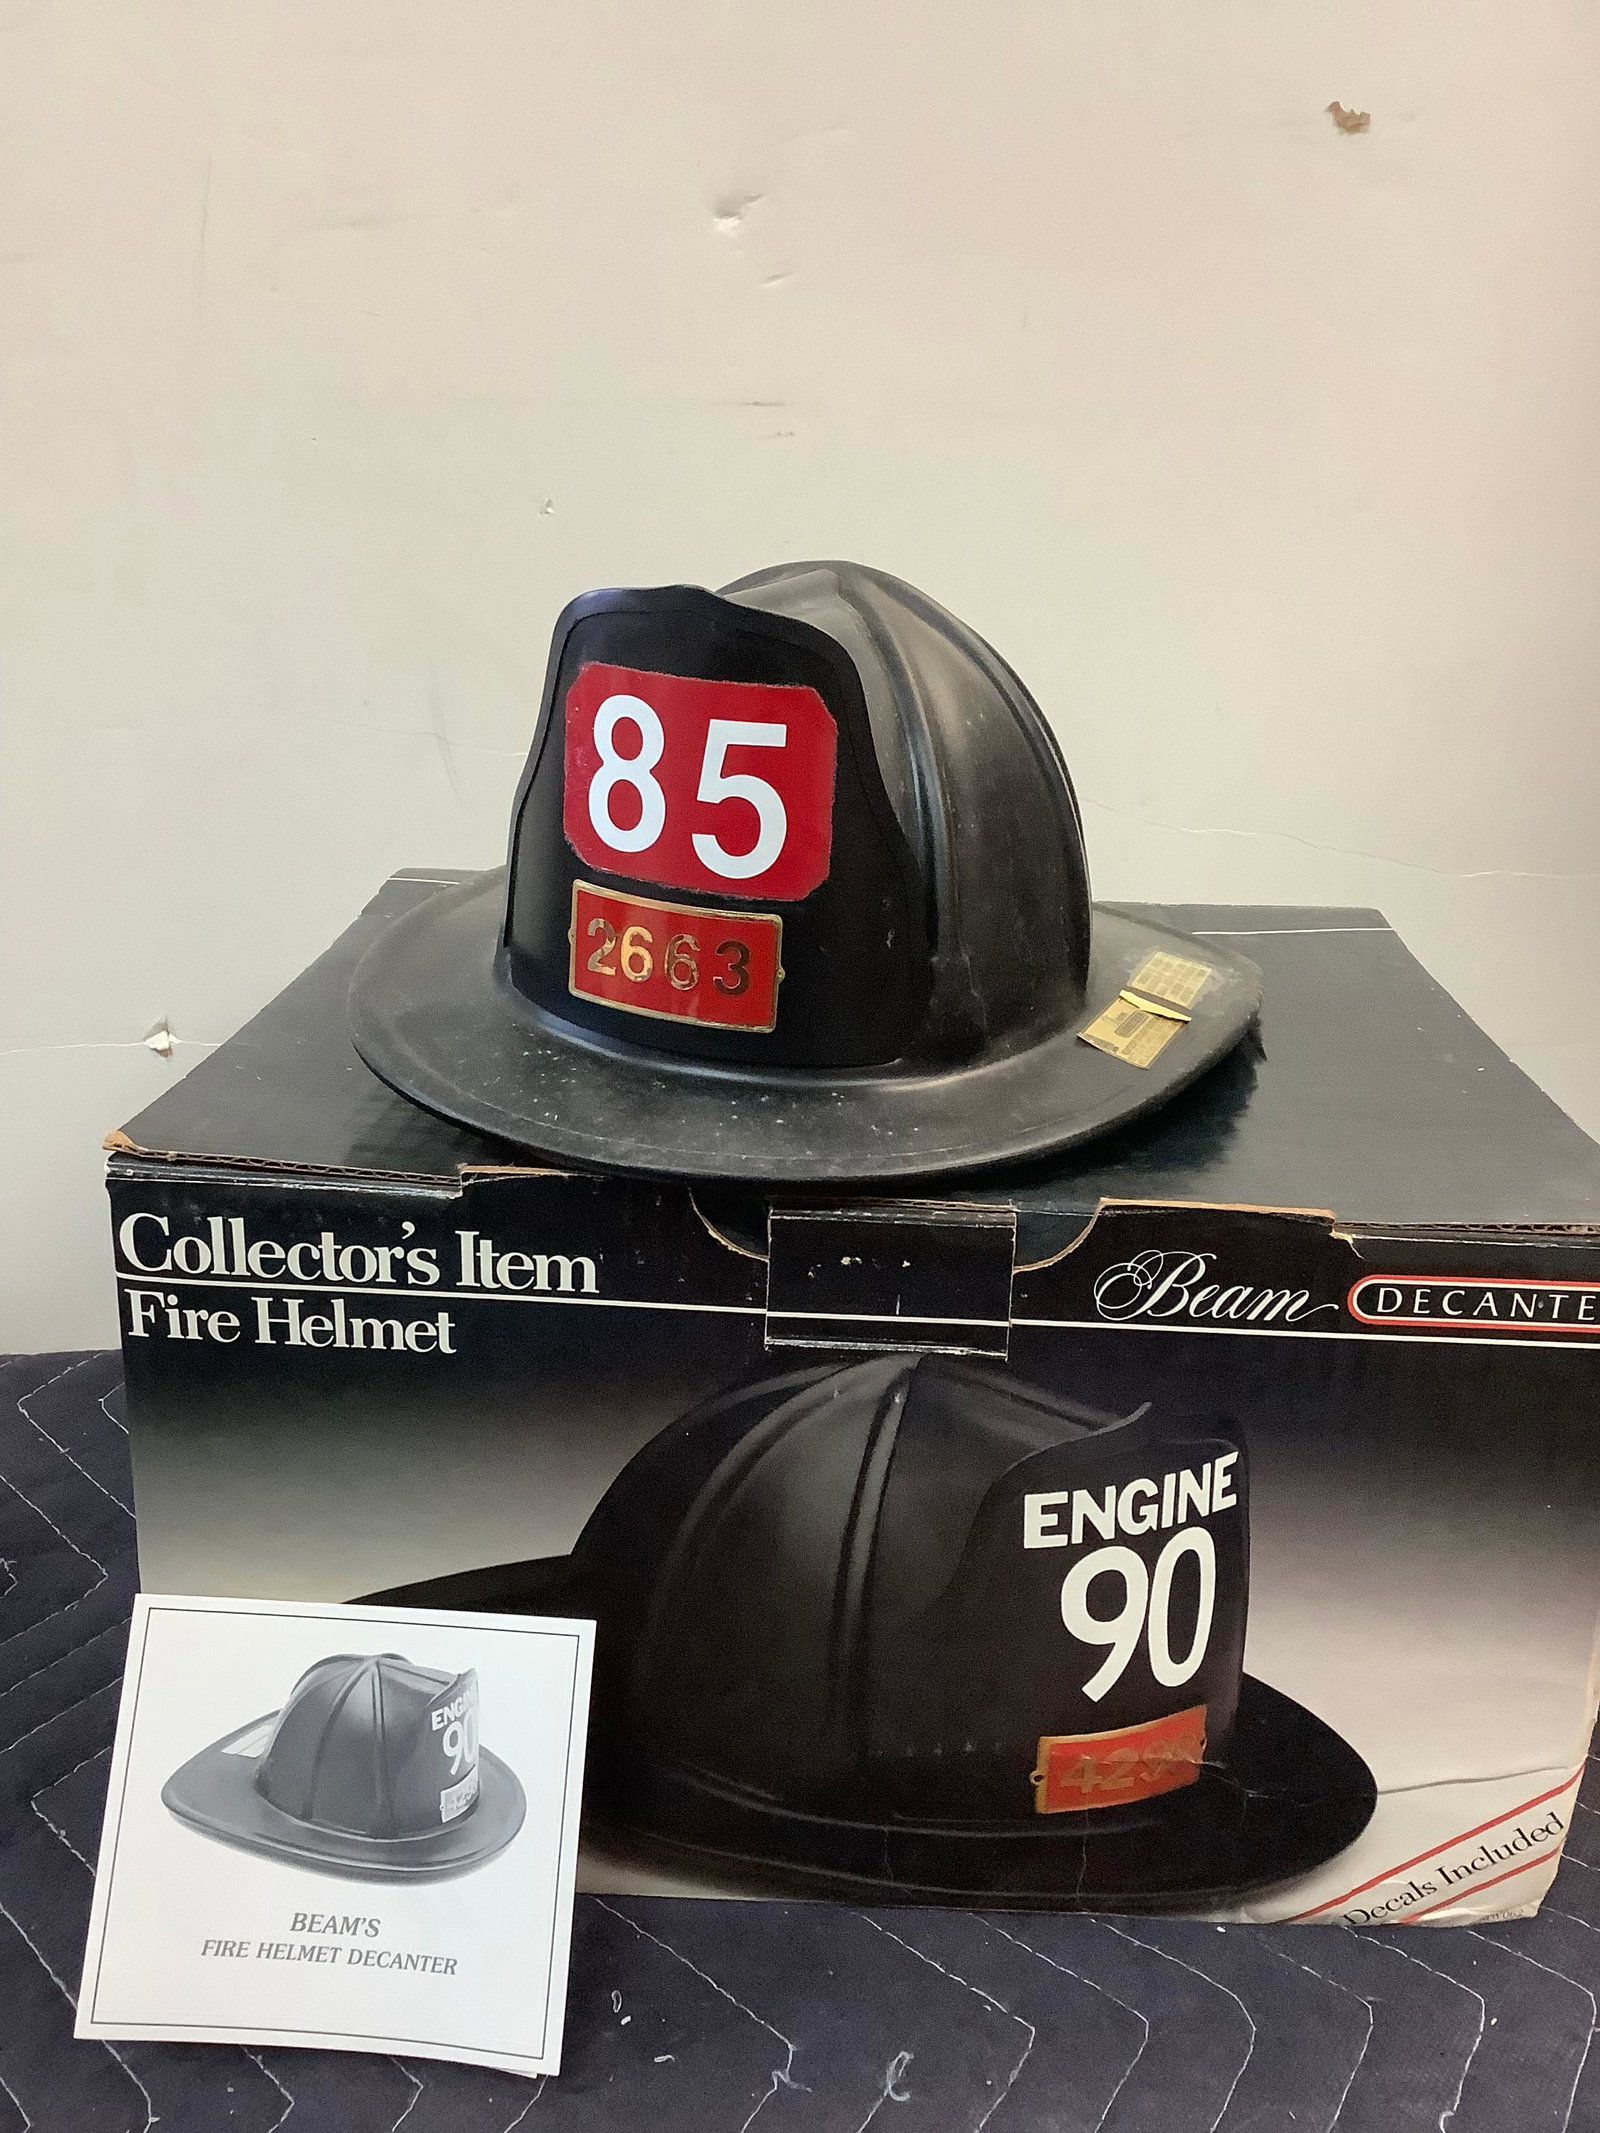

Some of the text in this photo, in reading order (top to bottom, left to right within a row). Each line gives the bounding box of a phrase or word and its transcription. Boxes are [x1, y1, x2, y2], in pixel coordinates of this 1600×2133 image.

[588, 694, 788, 880] 85
[586, 917, 751, 996] 2663
[119, 1212, 601, 1294] Collector's Item
[1093, 1248, 1339, 1323] Beam
[124, 1288, 457, 1355] Fire Helmet
[1377, 1286, 1598, 1321] DECANTE
[1023, 1450, 1239, 1549] ENGINE
[1060, 1525, 1217, 1703] 90
[442, 1708, 479, 1777] 90
[1341, 1811, 1565, 1925] Decals Included
[201, 1939, 458, 1975] FIRE HELMET DECANTER
[290, 1912, 382, 1938] BEAM'S
